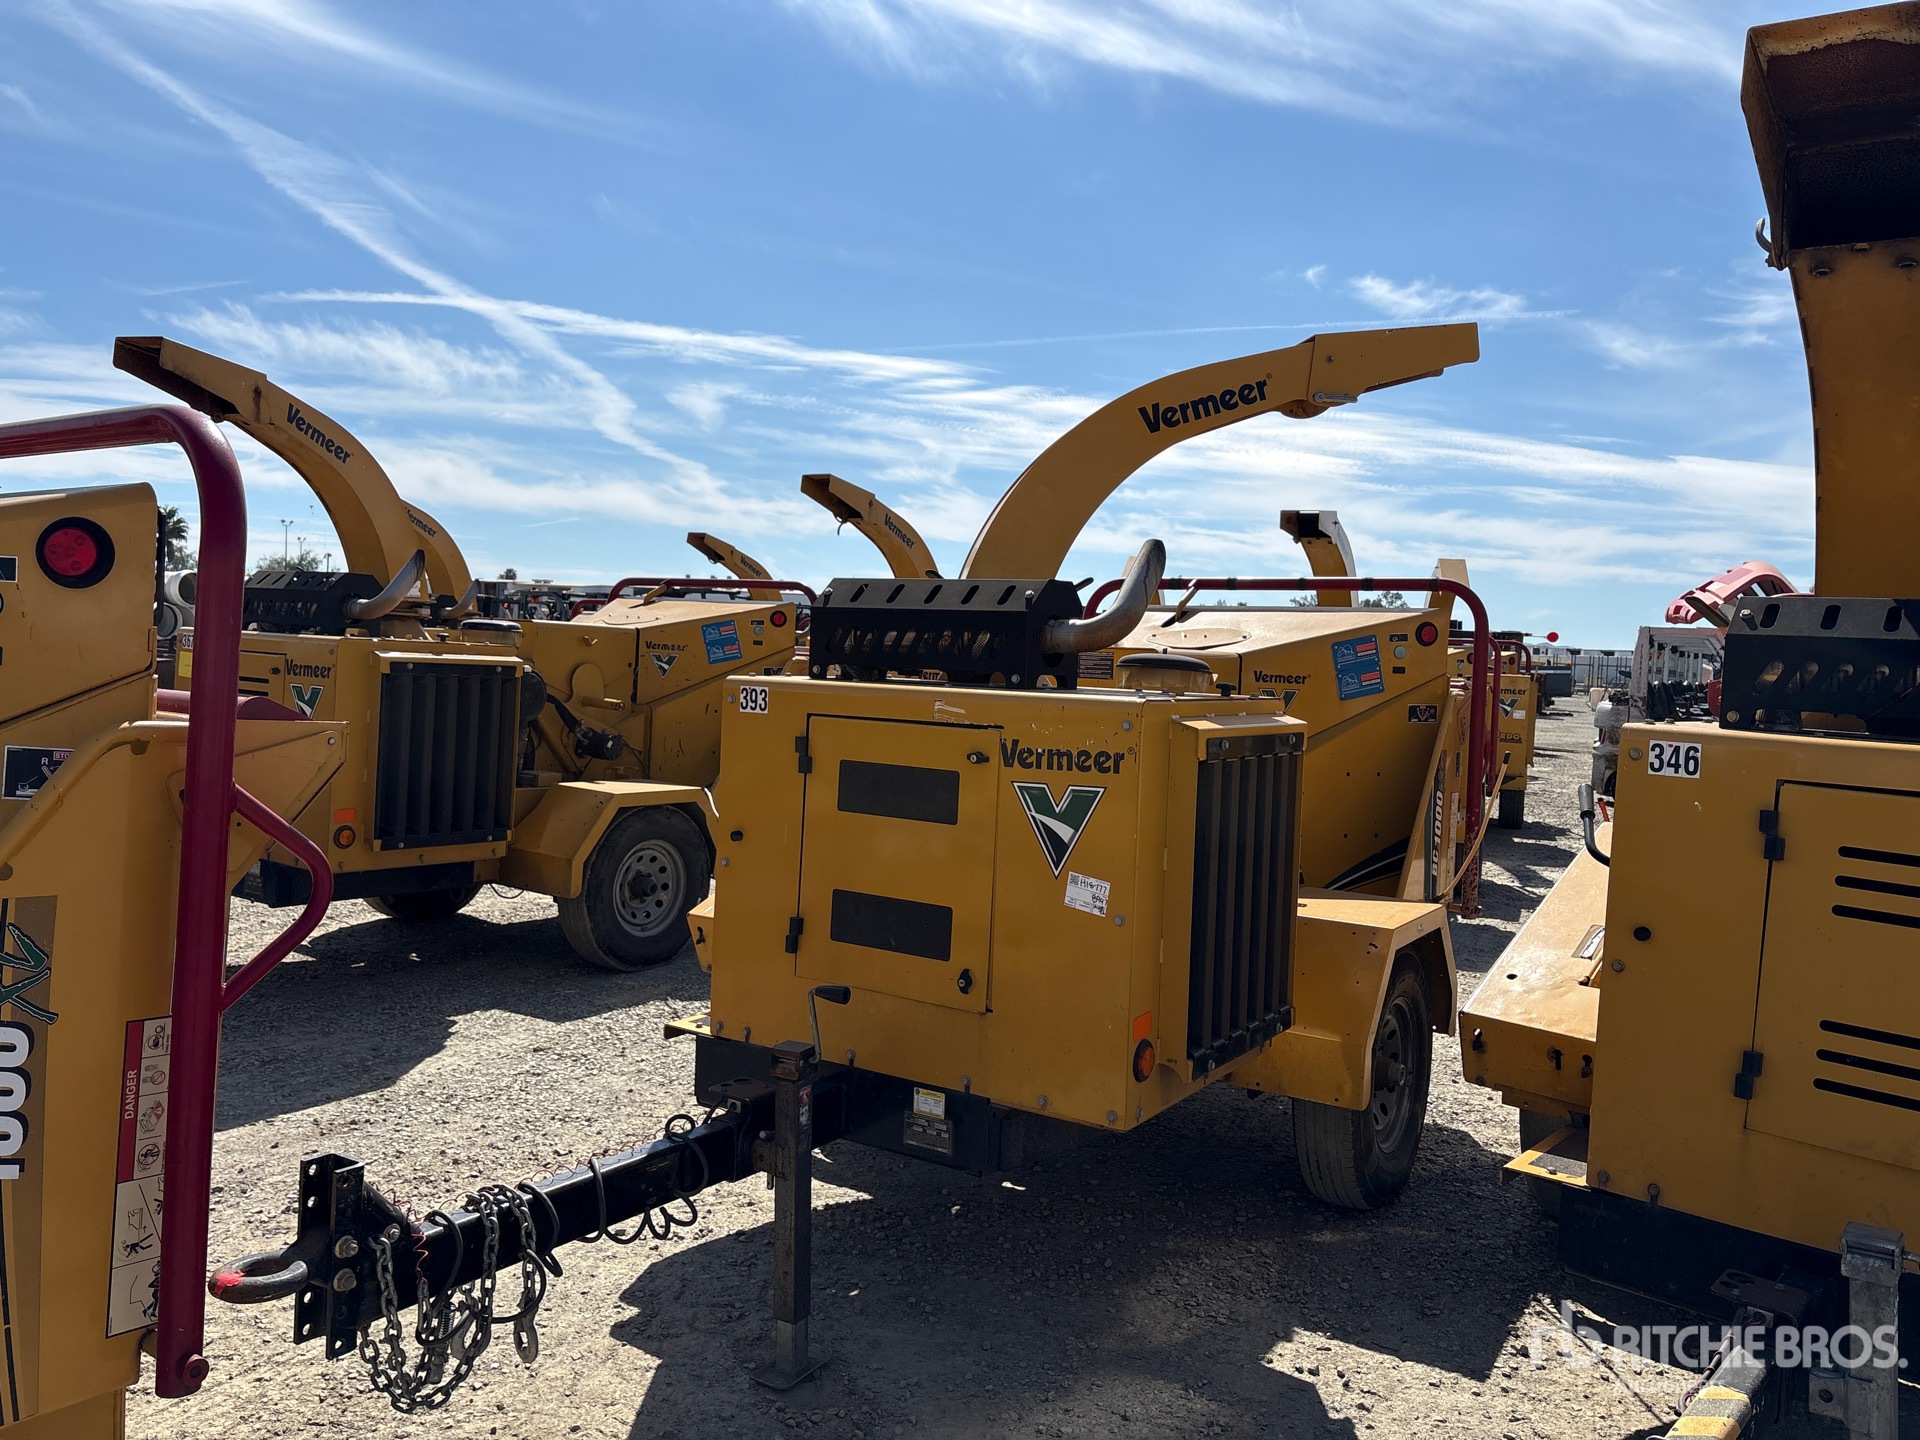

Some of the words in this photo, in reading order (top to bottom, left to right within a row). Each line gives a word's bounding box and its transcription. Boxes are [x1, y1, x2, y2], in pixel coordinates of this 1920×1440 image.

[1138, 378, 1268, 434] Vermeer
[286, 403, 351, 464] Vermeer
[884, 513, 915, 550] Vermeer
[740, 556, 762, 577] Vermeer
[645, 640, 686, 653] Vermeer
[285, 659, 332, 680] Vermeer
[1253, 670, 1308, 685] Vermeer
[740, 687, 768, 712] 393
[41, 757, 49, 765] R
[55, 752, 71, 760] STO
[1000, 738, 1125, 775] Vermeer
[1649, 742, 1700, 776] 346
[124, 1069, 138, 1120] DANGER
